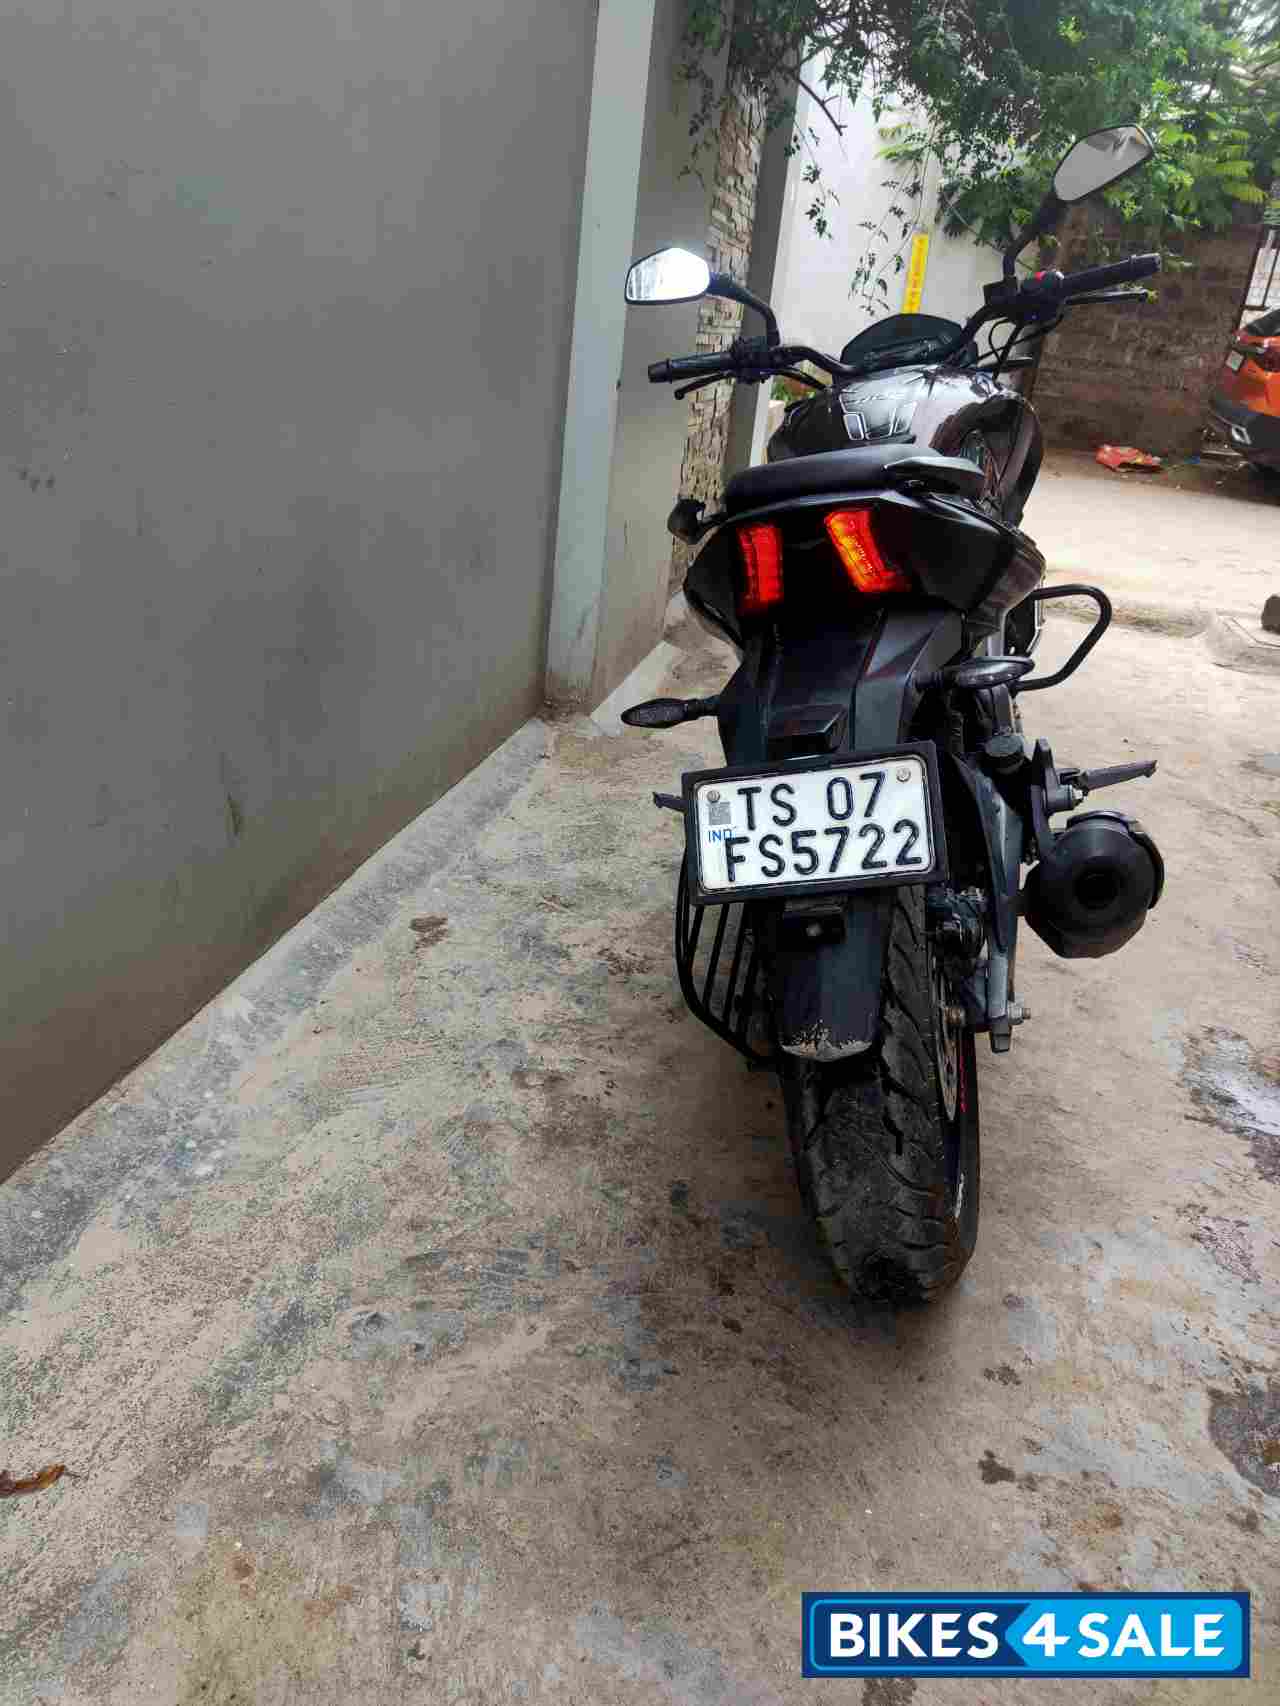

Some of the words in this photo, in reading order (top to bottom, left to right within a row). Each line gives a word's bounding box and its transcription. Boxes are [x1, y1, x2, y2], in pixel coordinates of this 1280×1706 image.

[737, 783, 798, 831] TS
[826, 770, 886, 821] 07
[708, 828, 733, 843] IND
[724, 818, 923, 882] FS5722
